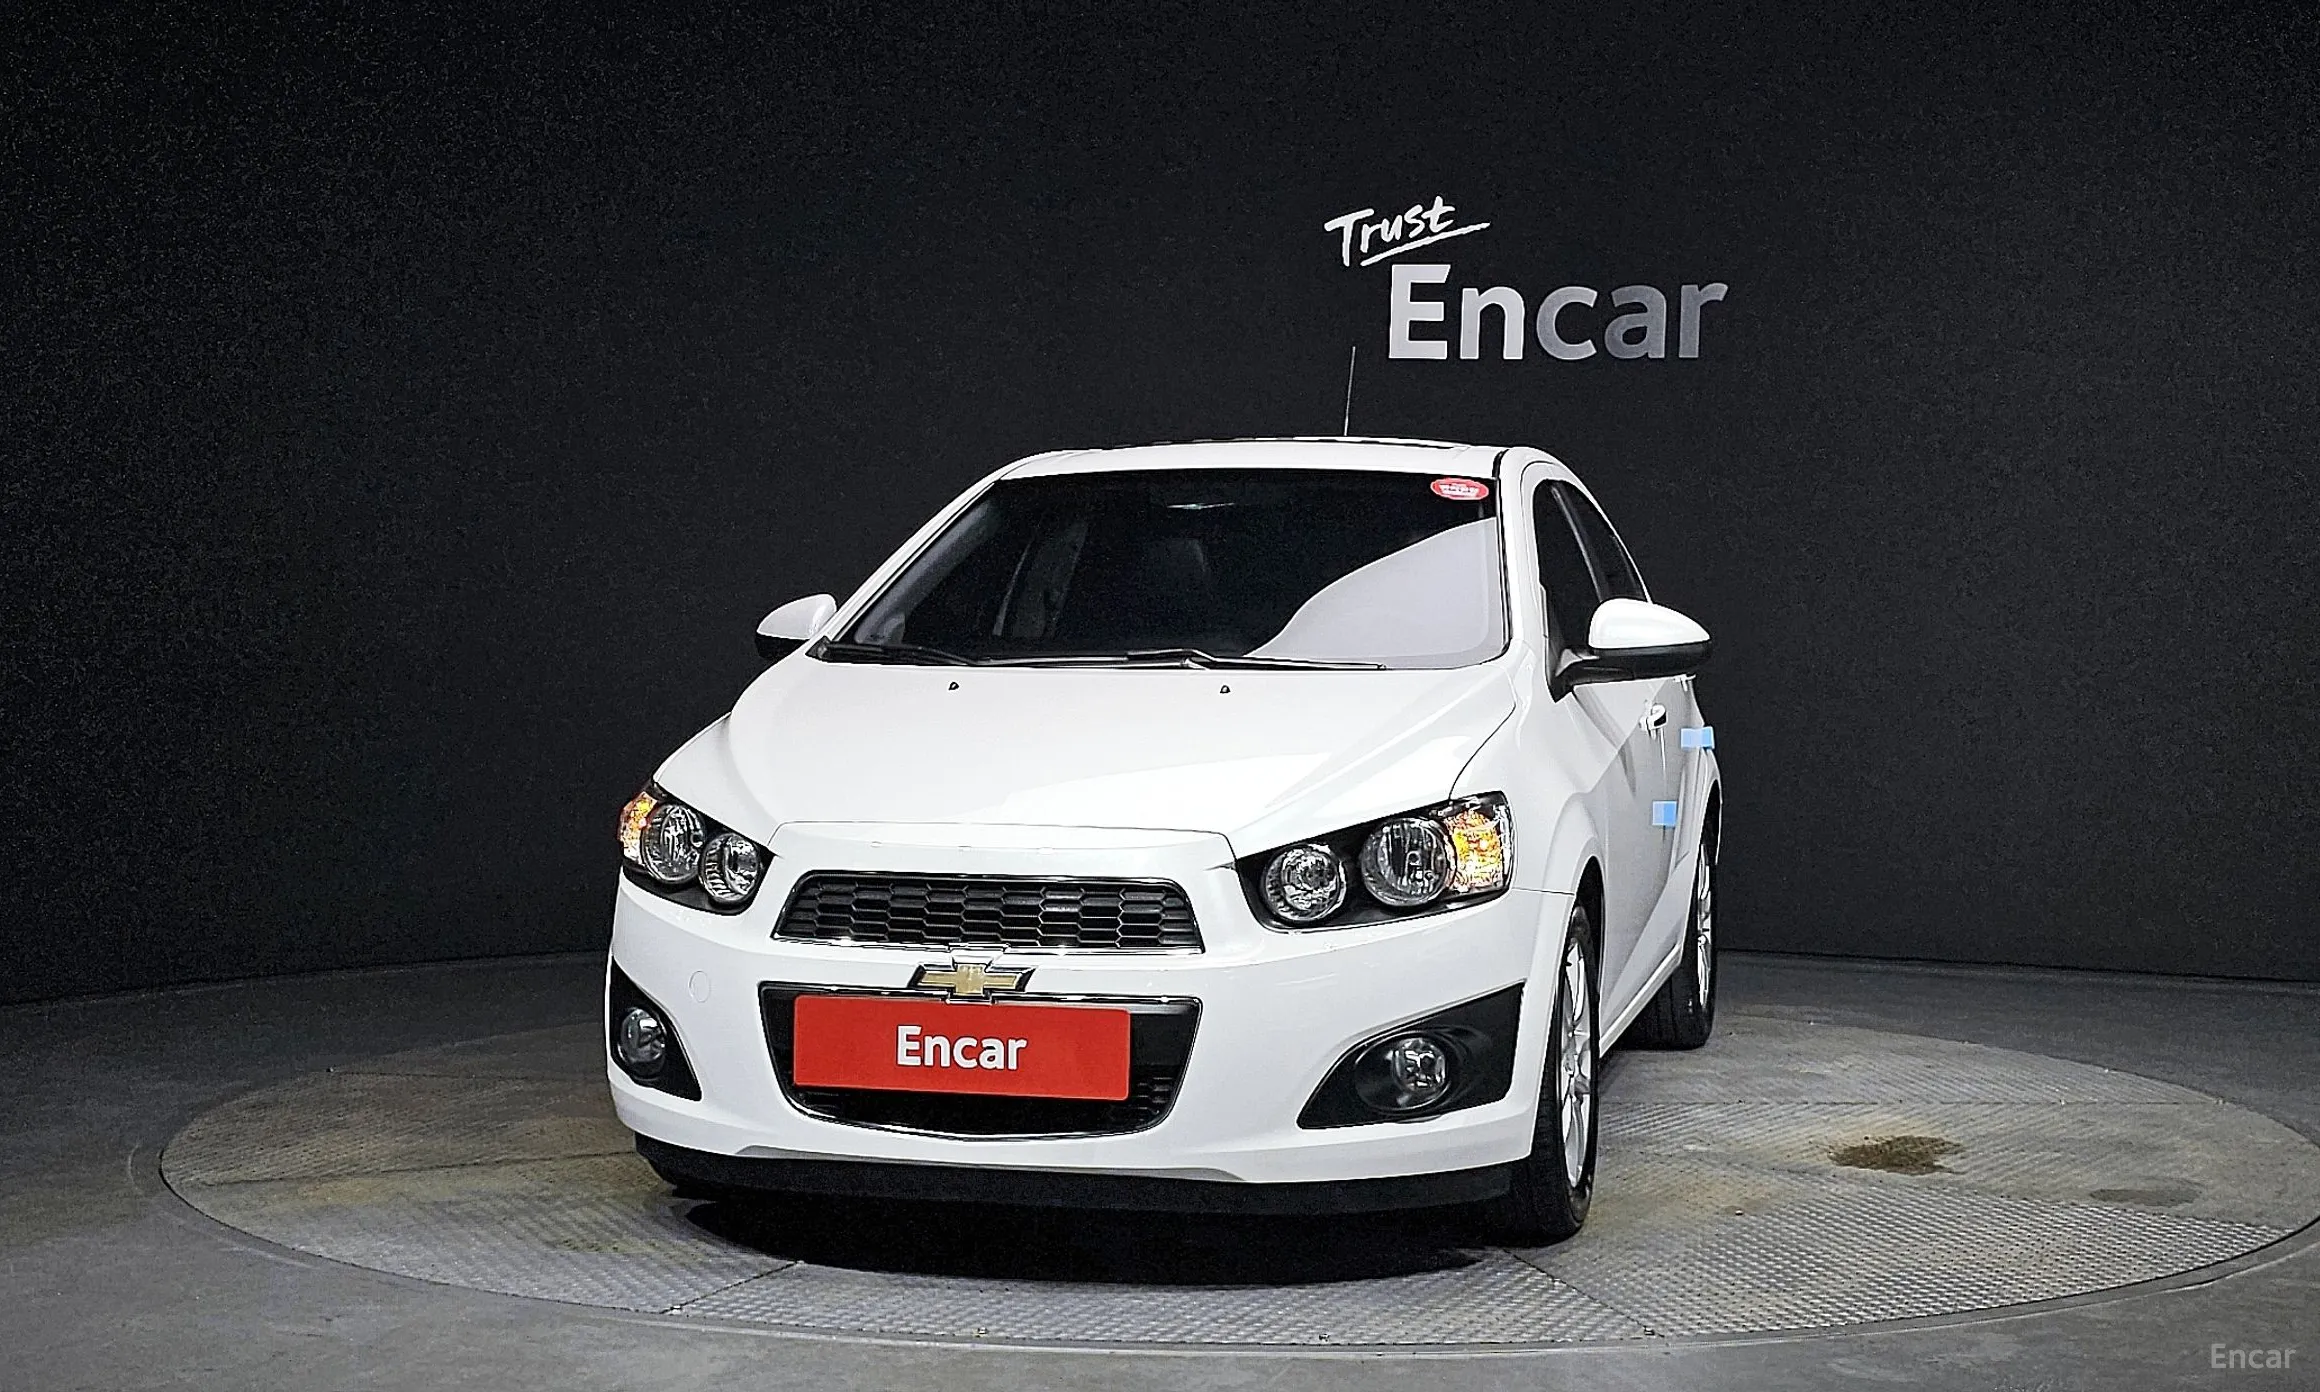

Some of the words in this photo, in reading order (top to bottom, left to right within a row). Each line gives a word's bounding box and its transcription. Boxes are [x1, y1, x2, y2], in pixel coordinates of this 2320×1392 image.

[1324, 196, 1456, 267] Trust
[1388, 264, 1729, 360] Encar
[896, 1025, 1027, 1070] Encar
